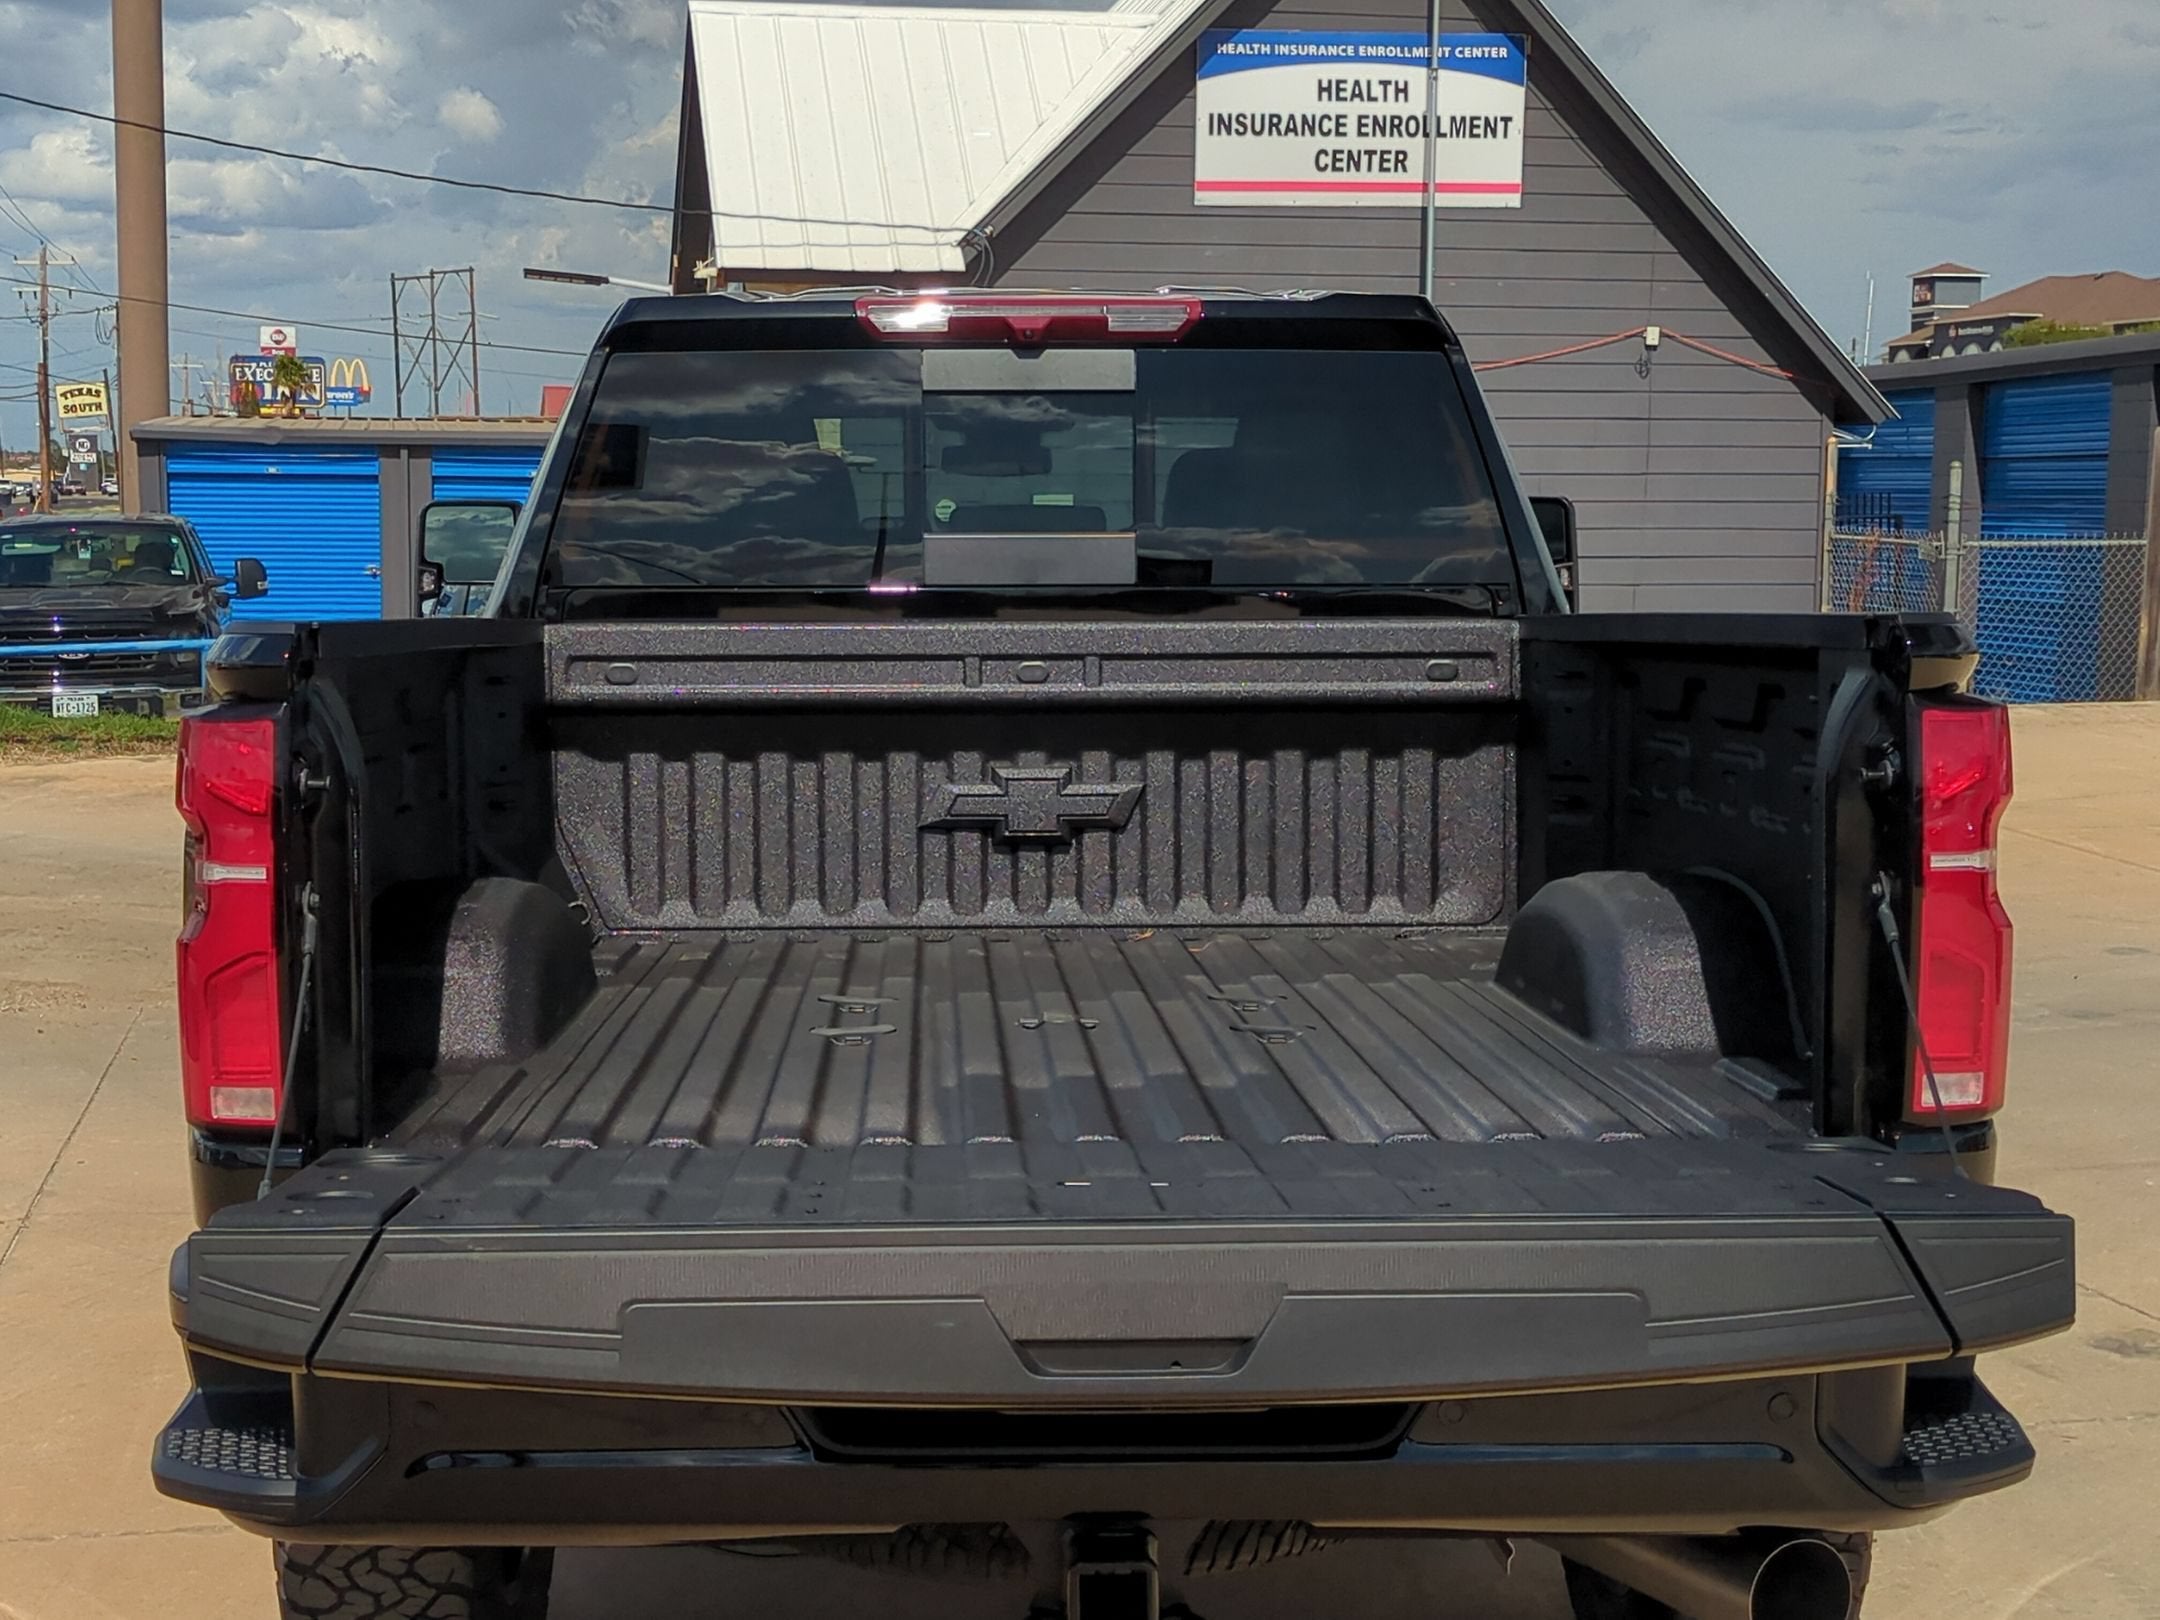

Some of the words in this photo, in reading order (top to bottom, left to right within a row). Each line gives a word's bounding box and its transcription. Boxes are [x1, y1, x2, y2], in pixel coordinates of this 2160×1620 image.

[1217, 43, 1270, 55] HEALTH
[1274, 44, 1355, 57] INSURANCE
[1455, 47, 1508, 59] CENTER
[1317, 78, 1409, 103] HEALTH
[1208, 112, 1348, 137] INSURANCE
[1356, 114, 1513, 139] ENROLLMENT
[1314, 148, 1408, 173] CENTER
[235, 367, 321, 382] EXECE
[60, 387, 102, 400] TEXAS
[63, 402, 102, 414] SOUTH
